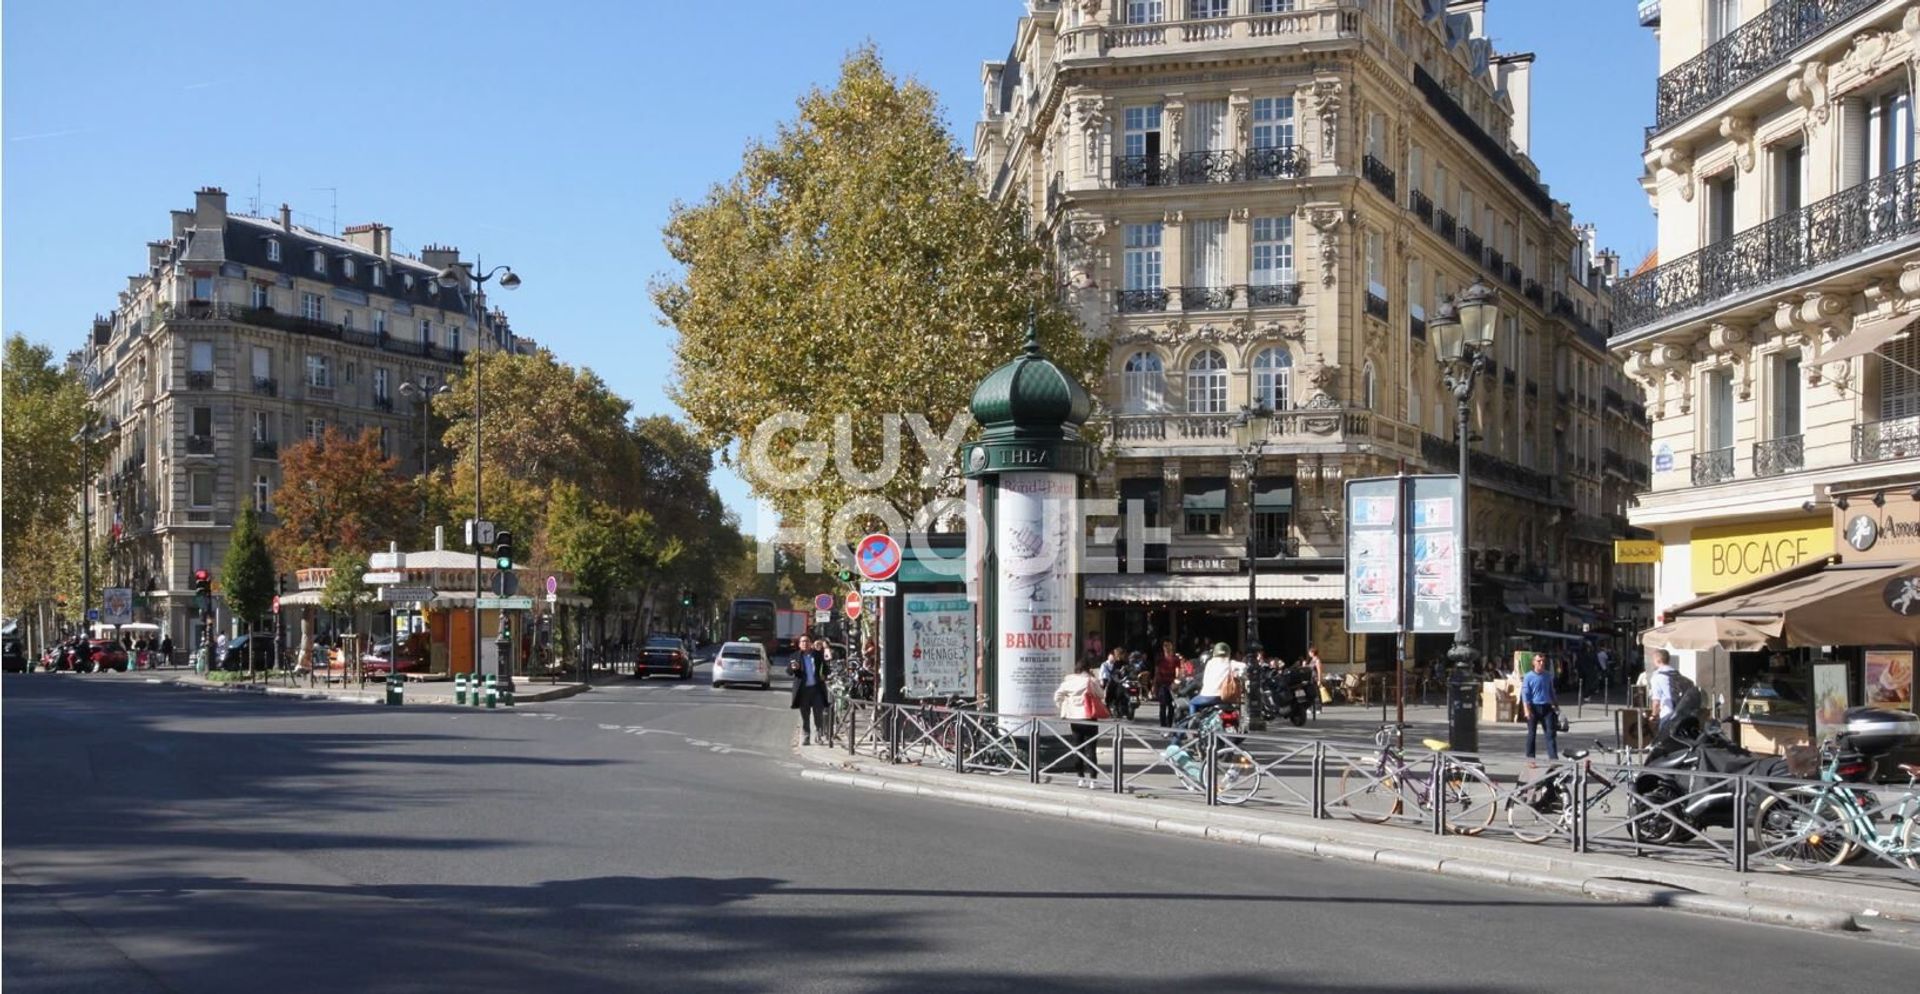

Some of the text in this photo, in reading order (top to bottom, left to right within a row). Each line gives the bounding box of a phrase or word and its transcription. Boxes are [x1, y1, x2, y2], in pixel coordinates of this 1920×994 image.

[1181, 560, 1193, 569] LE
[1711, 537, 1808, 576] BOCAGE
[1031, 615, 1052, 631] LE
[1006, 633, 1073, 651] BANQUET
